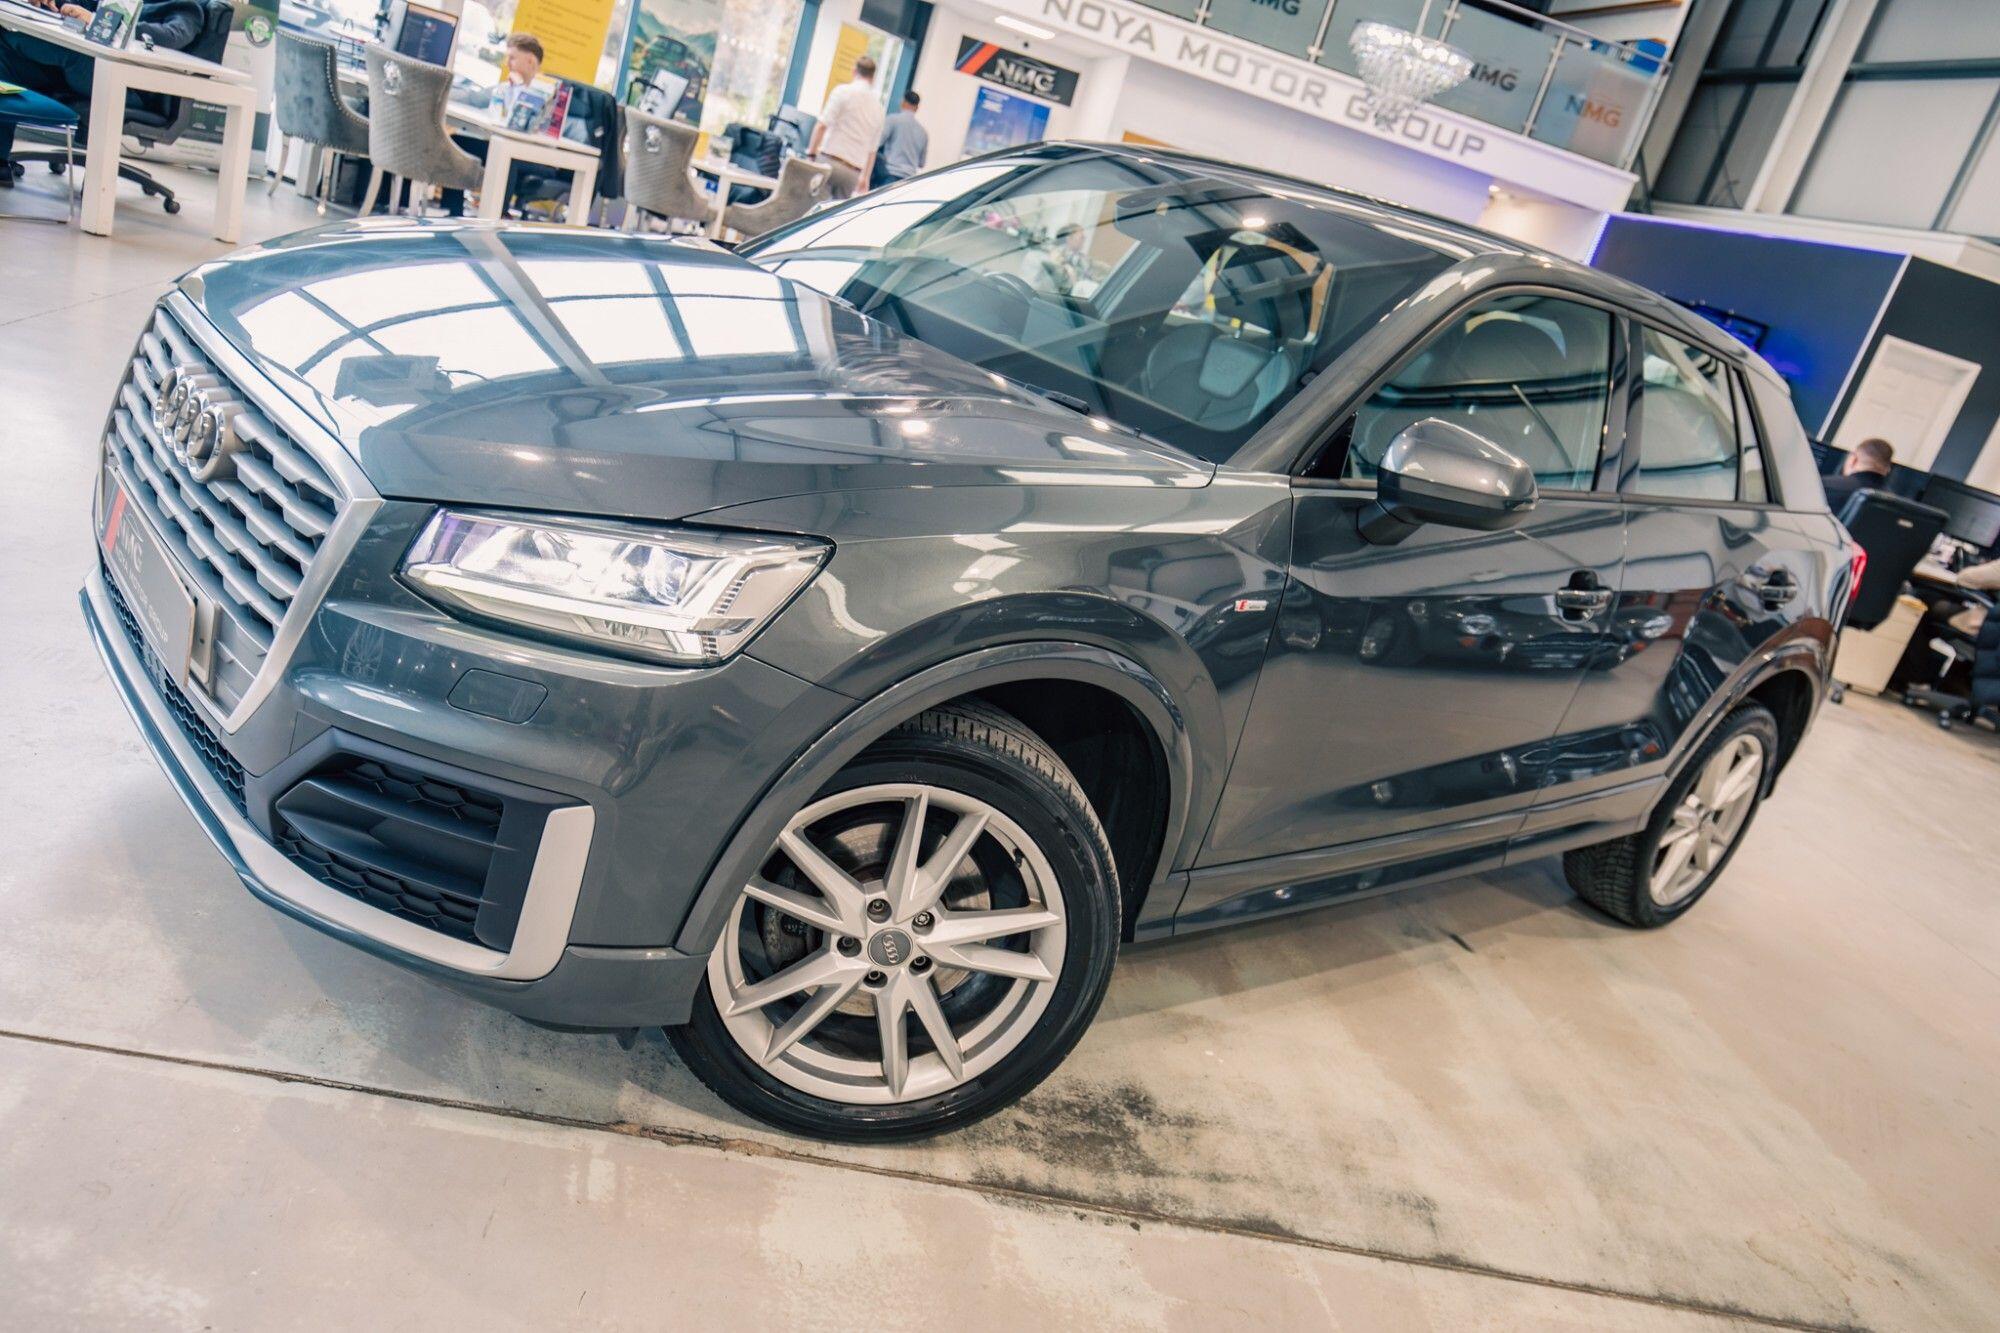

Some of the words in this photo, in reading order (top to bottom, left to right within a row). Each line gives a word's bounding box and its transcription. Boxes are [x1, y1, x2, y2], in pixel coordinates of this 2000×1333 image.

[1043, 0, 1155, 51] NOYA
[1176, 35, 1327, 108] MOTOR
[994, 58, 1055, 92] NMG
[1564, 94, 1622, 129] NMG
